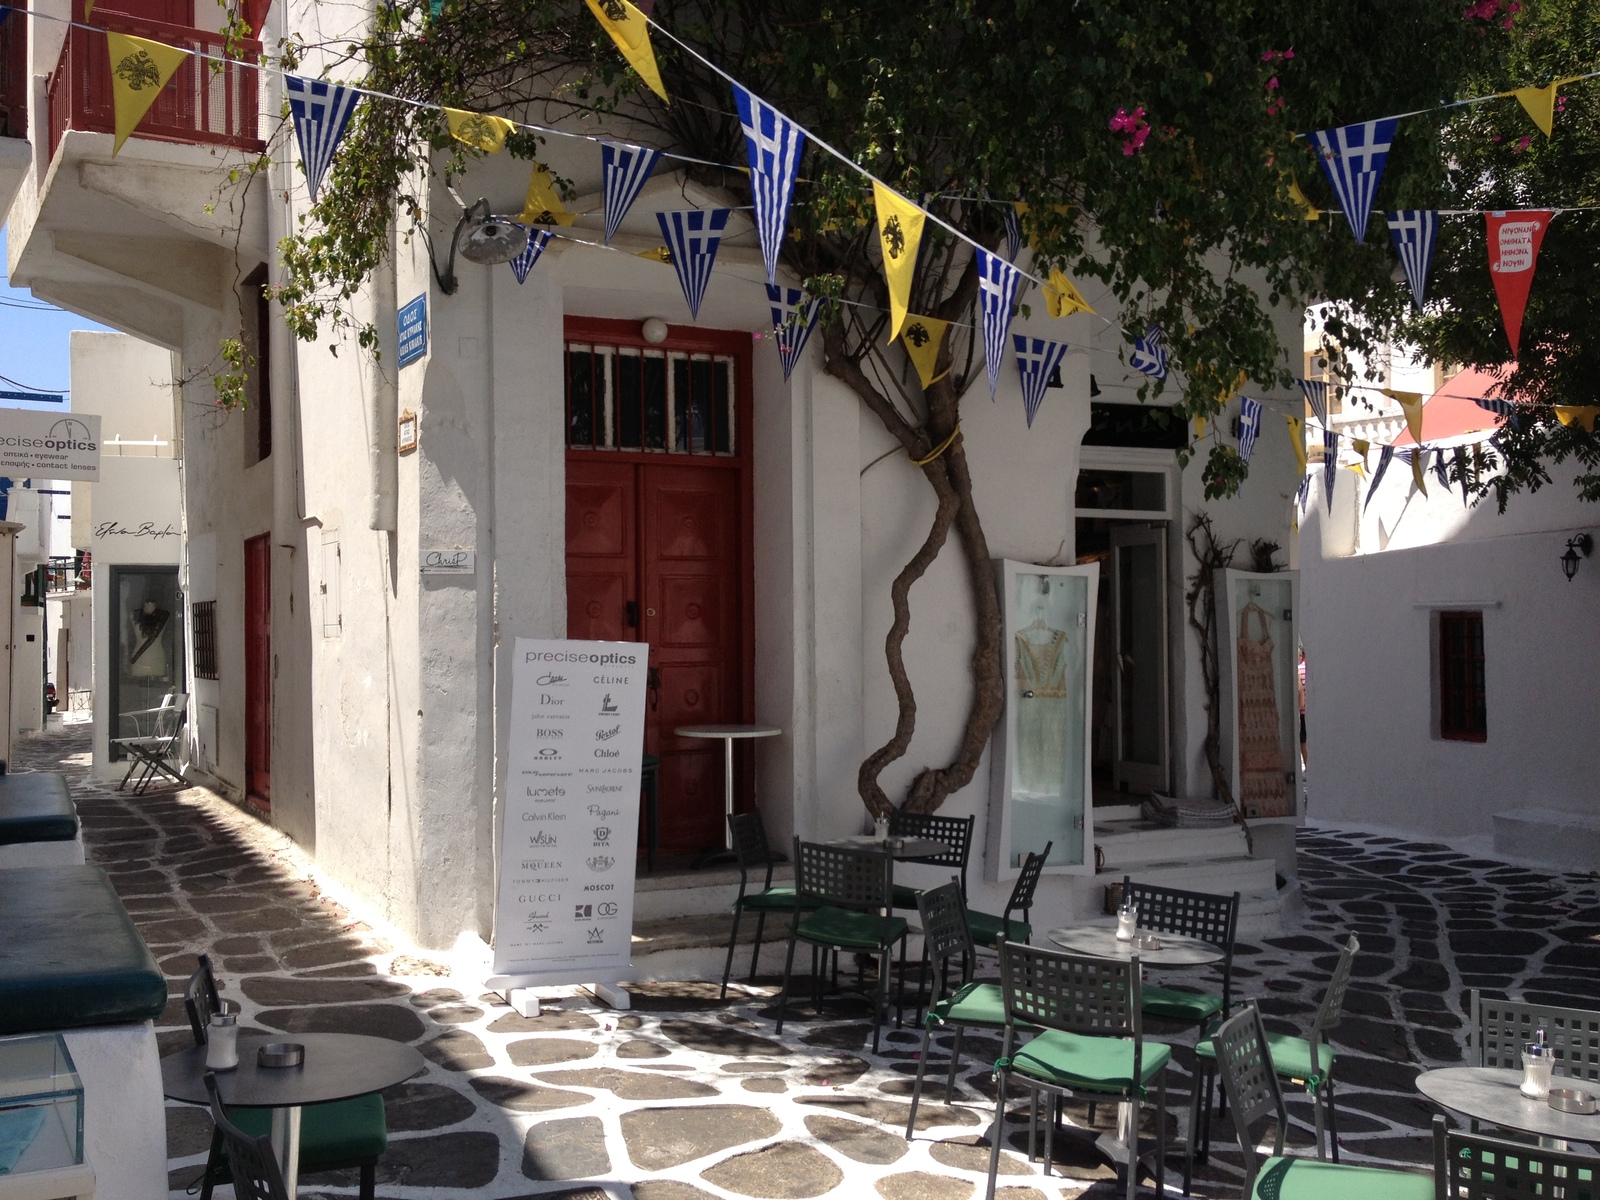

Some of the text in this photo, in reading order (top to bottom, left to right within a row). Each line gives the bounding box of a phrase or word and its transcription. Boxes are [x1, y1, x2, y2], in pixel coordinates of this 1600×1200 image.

[526, 650, 636, 665] preciseoptics
[593, 675, 629, 684] CÉLINE
[540, 694, 564, 705] Dior
[536, 729, 564, 737] BOSS
[594, 749, 620, 758] Chloé
[522, 812, 566, 822] Calvin Klein
[587, 805, 620, 821] Pagani
[518, 894, 561, 903] GUCCI
